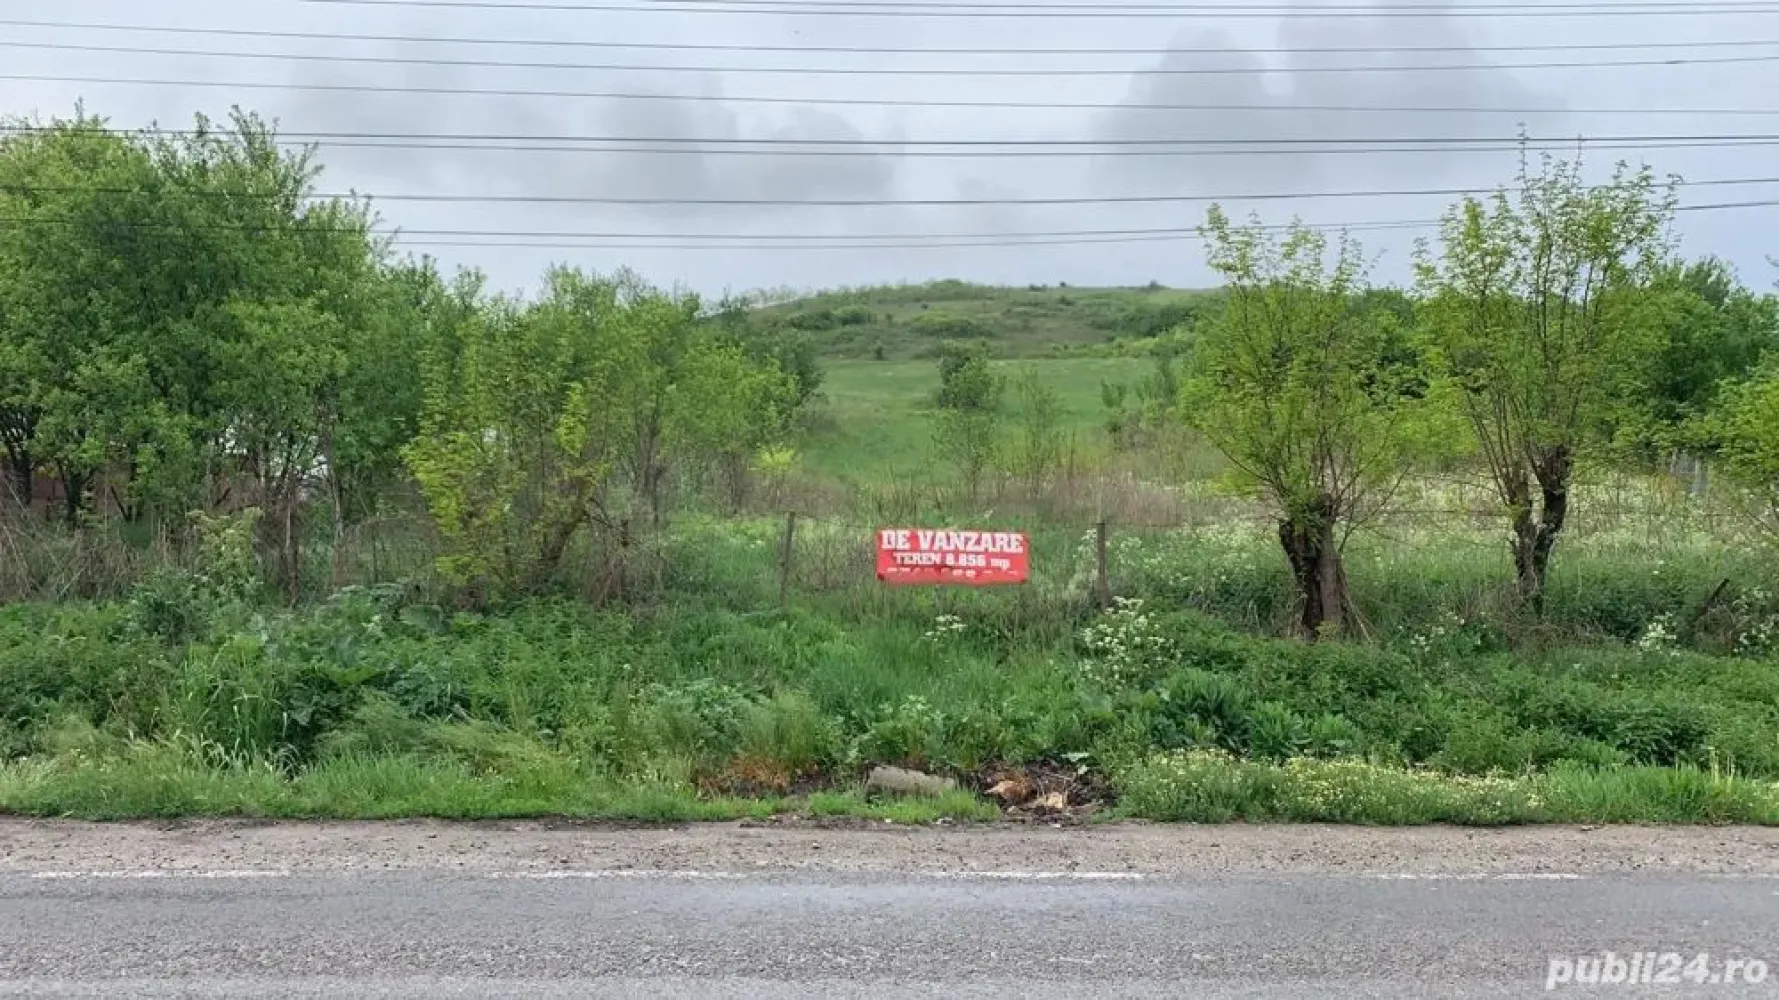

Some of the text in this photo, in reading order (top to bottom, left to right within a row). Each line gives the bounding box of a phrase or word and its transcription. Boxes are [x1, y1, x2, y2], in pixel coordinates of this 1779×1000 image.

[881, 529, 1024, 553] DE VANZARE
[892, 552, 942, 565] TEREN
[990, 558, 1010, 570] mp
